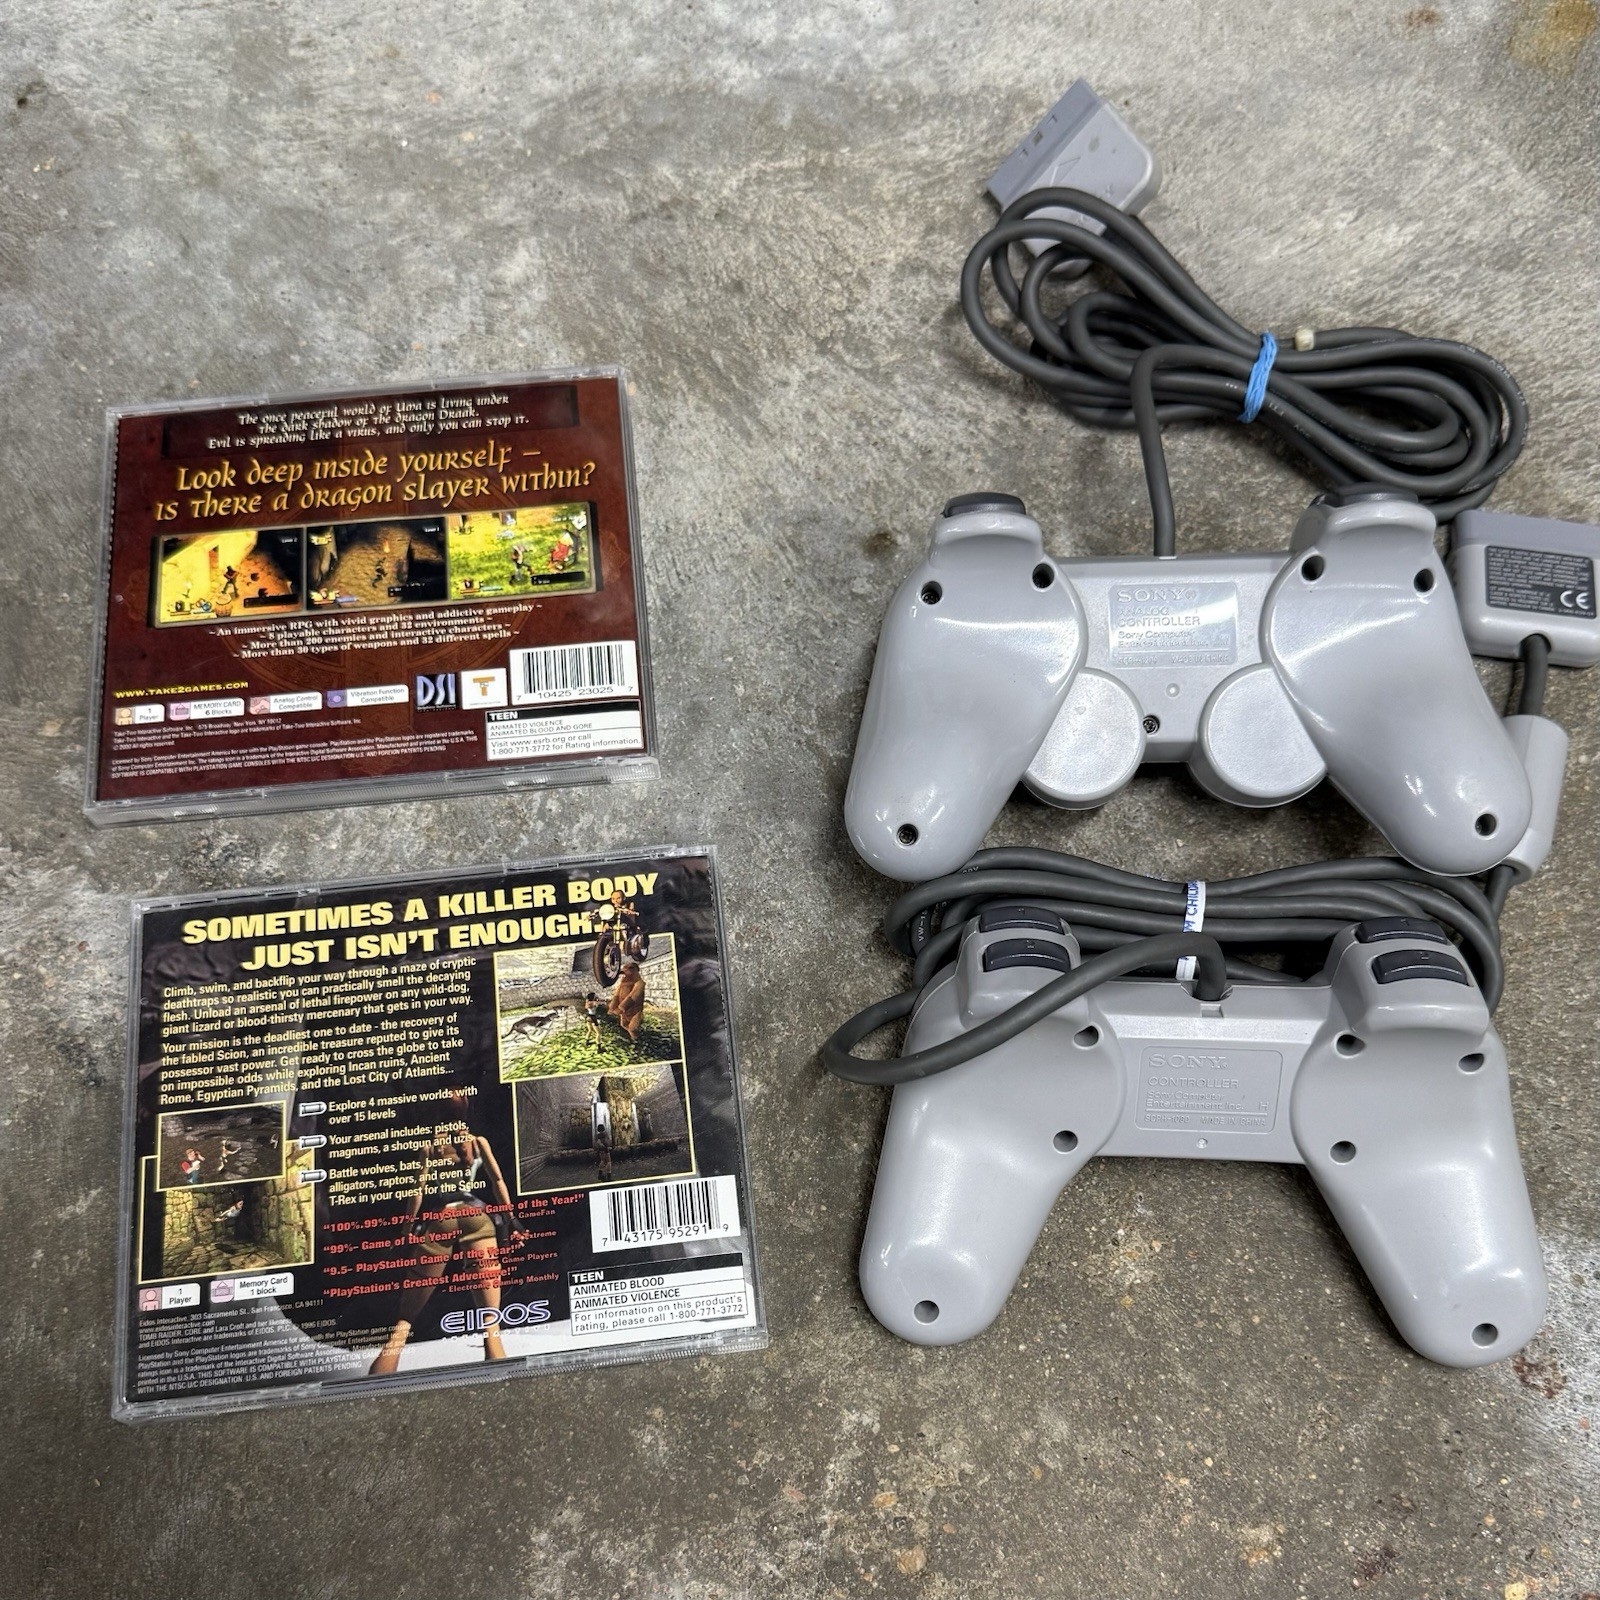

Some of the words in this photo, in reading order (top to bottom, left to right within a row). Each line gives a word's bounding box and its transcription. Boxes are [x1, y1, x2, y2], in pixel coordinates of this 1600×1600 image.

[238, 413, 258, 425] The
[261, 413, 286, 423] once
[290, 405, 338, 423] peaceful
[342, 402, 375, 415] world
[378, 404, 392, 415] of
[395, 401, 421, 412] Uma
[426, 398, 437, 410] is
[440, 397, 472, 408] living
[476, 393, 508, 405] under
[258, 422, 277, 434] the
[280, 419, 308, 432] dark
[312, 416, 352, 429] shadow
[355, 417, 368, 427] of
[372, 412, 390, 424] the
[394, 411, 434, 423] dragon
[438, 405, 479, 419] Draak.
[208, 436, 230, 448] Evil
[235, 438, 245, 446] is
[249, 431, 305, 448] spreading
[309, 428, 331, 440] like
[335, 430, 342, 438] a
[347, 427, 380, 437] virus,
[385, 421, 405, 434] and
[409, 419, 434, 434] only
[437, 420, 458, 434] you
[461, 419, 481, 428] can
[485, 416, 511, 428] stop
[515, 415, 529, 424] it.
[177, 460, 236, 490] Look
[247, 458, 303, 490] deep
[314, 449, 387, 479] inside
[396, 439, 512, 482] yourself
[156, 501, 178, 520] is
[190, 489, 261, 518] there
[272, 492, 288, 511] a
[299, 482, 392, 511] dragon
[402, 472, 490, 507] slayer
[499, 461, 595, 493] within?
[1117, 589, 1184, 603] SONY
[1118, 616, 1200, 627] CONTROLLER
[114, 681, 248, 698] WWW.TAKE2GAMES.COM
[416, 672, 455, 706] DSI
[537, 689, 571, 698] 10425
[578, 685, 613, 696] 23025
[138, 712, 159, 722] Player
[488, 710, 518, 720] TEEN
[489, 722, 527, 730] ANIMATED
[528, 719, 562, 727] VIOLENCE
[490, 740, 508, 748] Visit
[509, 736, 565, 746] www.esrb.org
[577, 732, 591, 740] call
[491, 743, 550, 755] 1-800-771-3772
[564, 740, 591, 751] Rating
[592, 737, 640, 746] information.
[182, 901, 393, 943] SOMETIMES
[402, 898, 428, 922] A
[438, 884, 556, 917] KILLER
[567, 872, 658, 903] BODY
[240, 938, 334, 970] JUST
[345, 927, 438, 960] ISN'T
[163, 984, 197, 997] Climb,
[199, 981, 230, 994] swim,
[232, 978, 253, 990] and
[254, 974, 295, 988] backflip
[297, 974, 321, 986] your
[323, 971, 345, 982] way
[347, 964, 388, 979] through
[390, 966, 397, 974] a
[399, 962, 427, 973] maze
[429, 958, 440, 970] of
[441, 955, 476, 970] cryptic
[163, 996, 219, 1010] deathtraps
[221, 995, 234, 1004] so
[236, 989, 277, 1003] realistic
[279, 988, 299, 1000] you
[300, 986, 319, 996] can
[321, 978, 374, 996] practically
[376, 975, 404, 988] smell
[406, 974, 423, 985] the
[425, 969, 470, 983] decaying
[1149, 1054, 1226, 1069] SONY
[1147, 1076, 1239, 1088] CONTROLLER
[328, 1099, 366, 1112] Explore
[368, 1096, 375, 1106] 4
[376, 1092, 417, 1106] massive
[419, 1087, 453, 1101] worlds
[454, 1084, 477, 1098] with
[1146, 1089, 1174, 1099] Sony
[1174, 1091, 1225, 1101] Computer
[1146, 1098, 1222, 1110] Entertainment
[1225, 1101, 1244, 1110] Inc.
[328, 1114, 351, 1125] over
[353, 1110, 365, 1121] 15
[367, 1107, 396, 1120] levels
[1239, 1117, 1266, 1127] CHINA
[422, 1205, 483, 1222] PlayStation
[485, 1201, 514, 1213] Game
[517, 1199, 528, 1209] of
[531, 1198, 548, 1207] the
[517, 1209, 555, 1218] GameFan
[361, 1239, 391, 1250] Game
[394, 1236, 405, 1246] of
[408, 1233, 426, 1244] the
[601, 1236, 608, 1246] 7
[623, 1228, 663, 1243] 43175
[668, 1223, 706, 1238] 95291
[722, 1223, 728, 1232] 9
[239, 1279, 268, 1288] Memory
[269, 1275, 288, 1285] Card
[571, 1270, 603, 1283] TEEN
[177, 1287, 183, 1295] 1
[250, 1287, 255, 1296] 1
[256, 1286, 276, 1295] block
[573, 1281, 627, 1295] ANIMATED
[629, 1276, 664, 1289] BLOOD
[168, 1296, 191, 1305] Player
[574, 1294, 628, 1309] ANIMATED
[630, 1287, 680, 1302] VIOLENCE
[440, 1299, 551, 1332] EIDOS
[573, 1310, 591, 1322] For
[594, 1306, 654, 1319] information
[672, 1300, 693, 1311] this
[694, 1294, 742, 1310] product's
[575, 1321, 608, 1331] rating,
[611, 1317, 644, 1329] please
[647, 1312, 665, 1323] call
[669, 1303, 744, 1319] 1-800-771-3772
